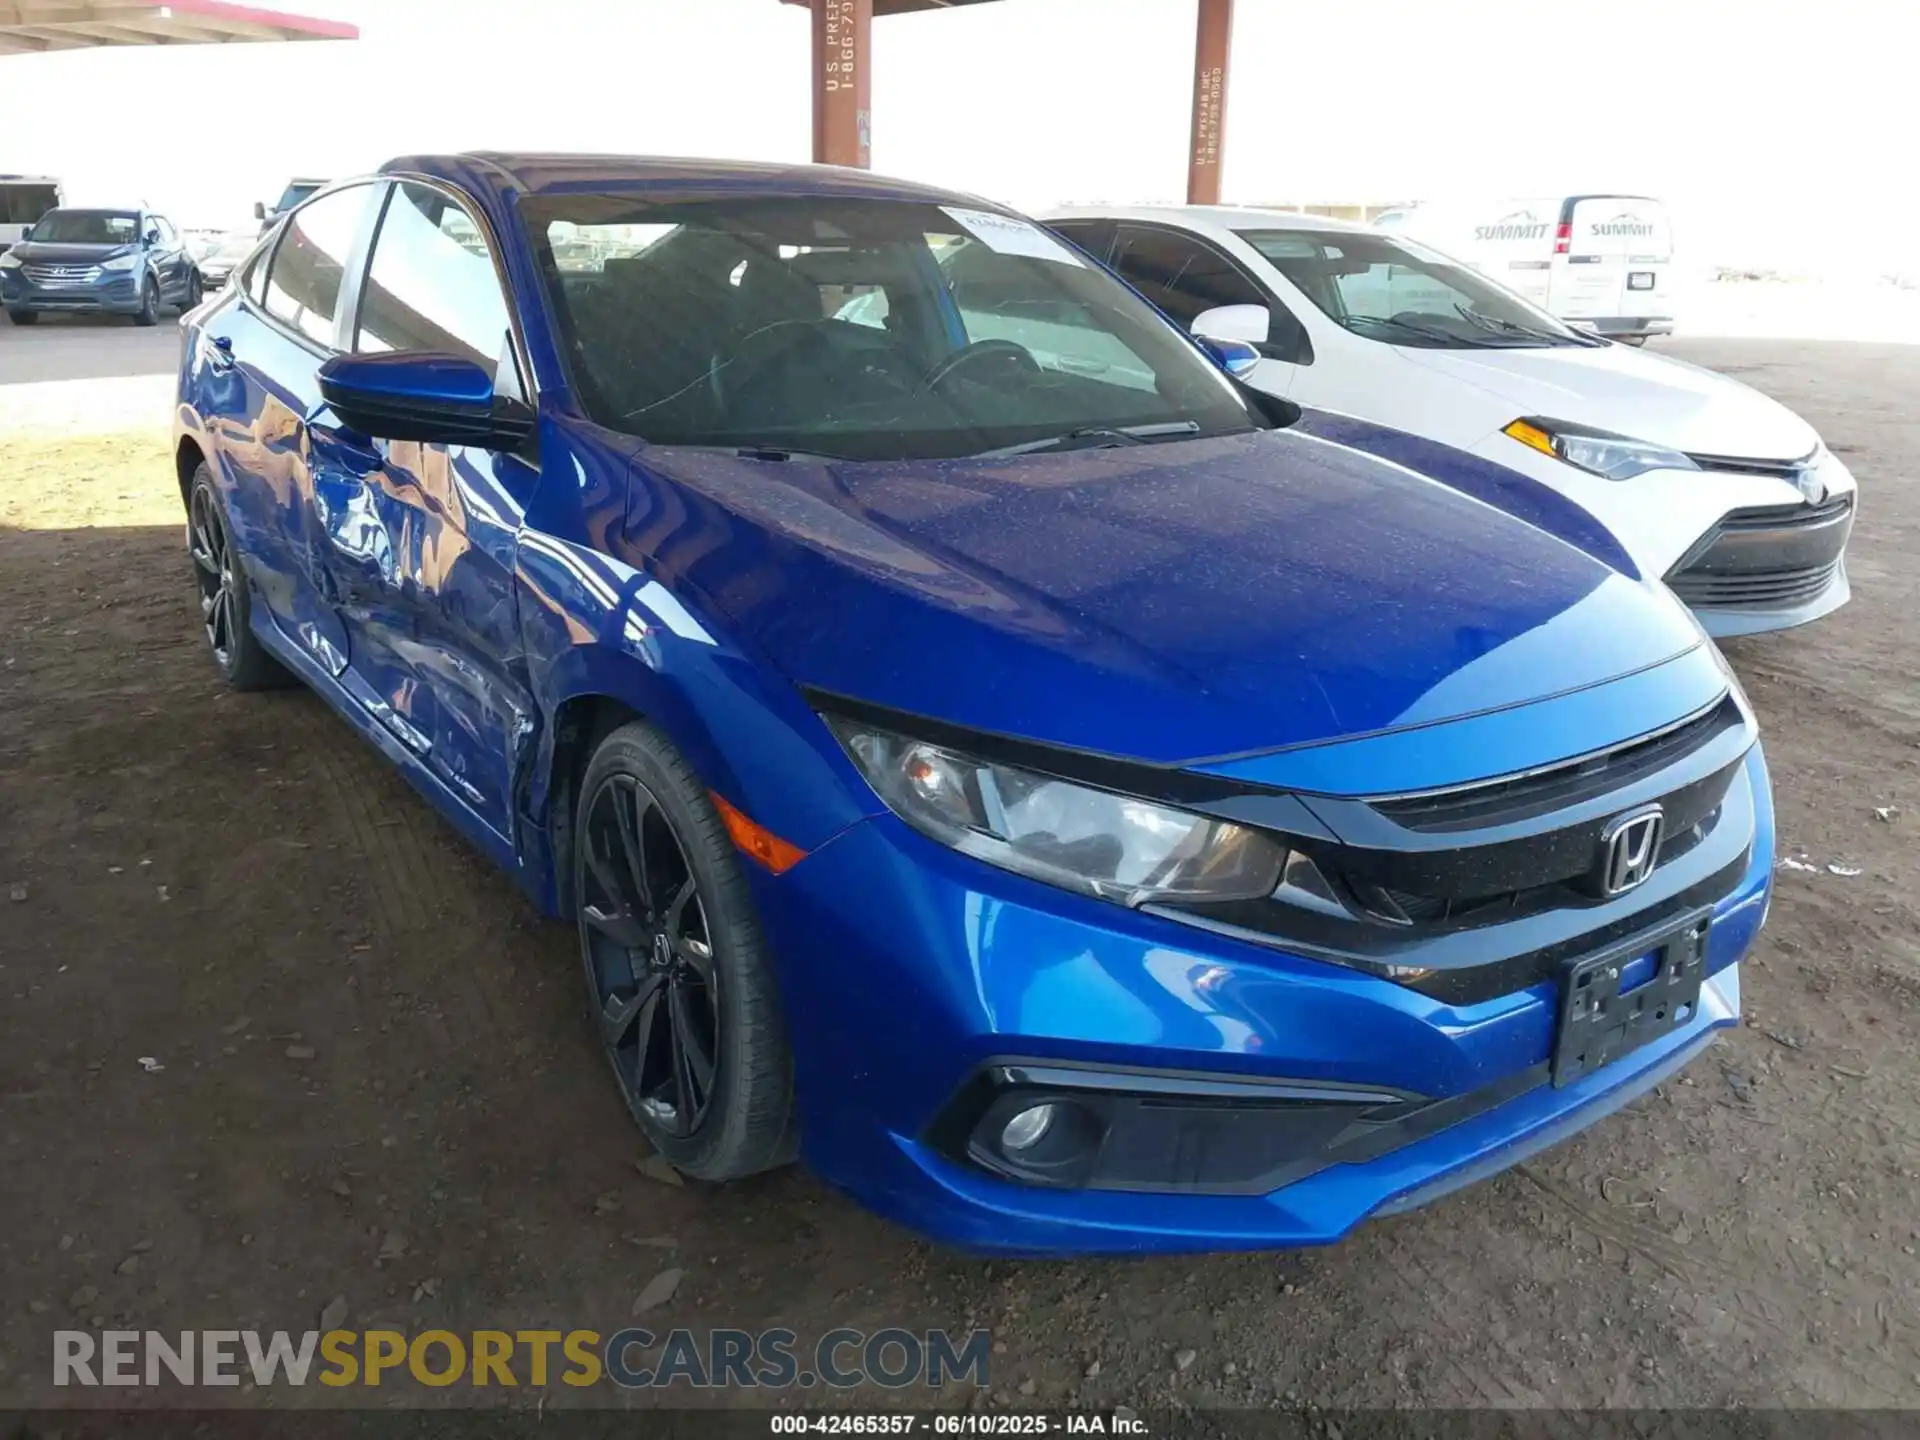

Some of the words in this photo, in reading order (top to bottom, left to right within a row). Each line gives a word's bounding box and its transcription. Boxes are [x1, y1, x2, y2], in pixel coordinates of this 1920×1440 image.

[826, 56, 839, 91] U.S.
[1474, 223, 1550, 241] SUMMIT
[1591, 223, 1654, 236] SUMMIT
